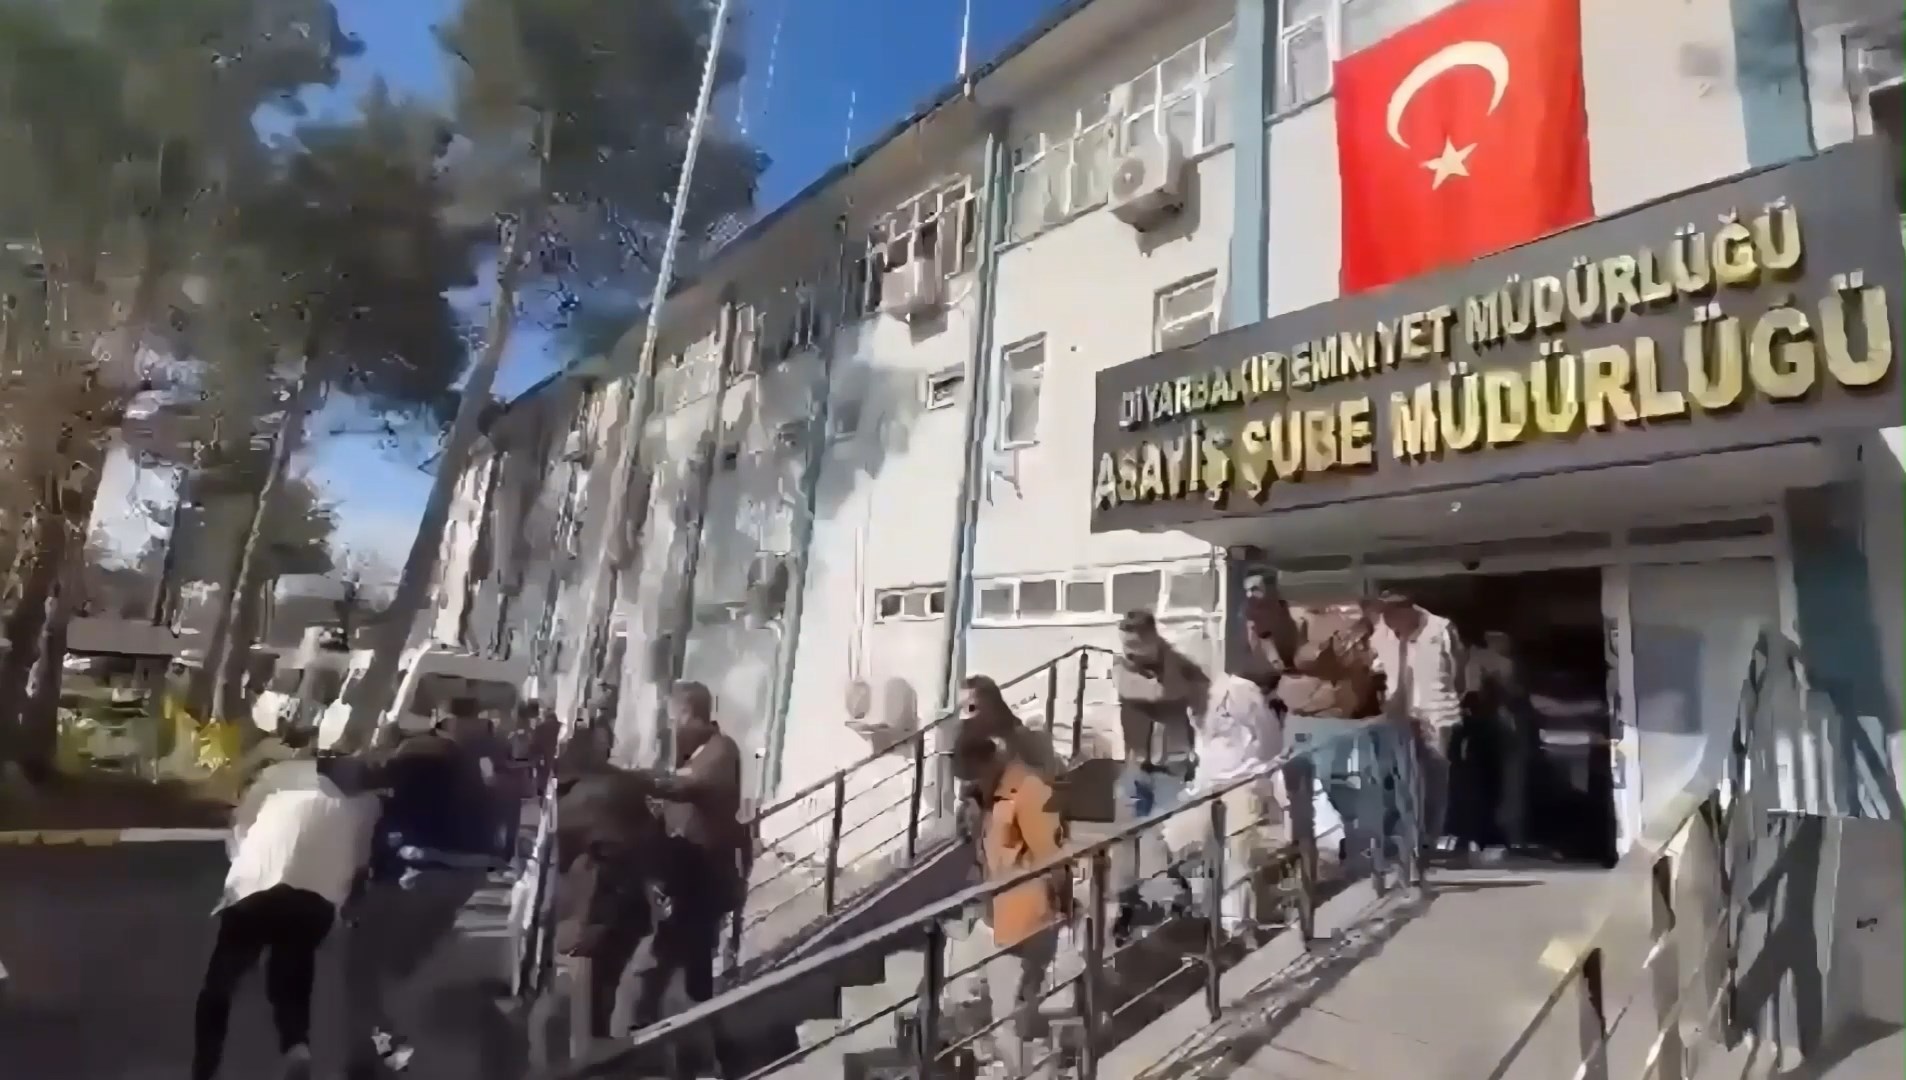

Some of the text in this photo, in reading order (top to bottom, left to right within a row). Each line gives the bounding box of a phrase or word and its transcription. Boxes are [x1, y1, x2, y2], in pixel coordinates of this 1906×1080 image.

[1463, 195, 1801, 347] MÜDÜRLÜĞÜ
[1240, 395, 1373, 501] ŞUBE
[1391, 267, 1893, 460] MÜDÜRLÜĞÜ
